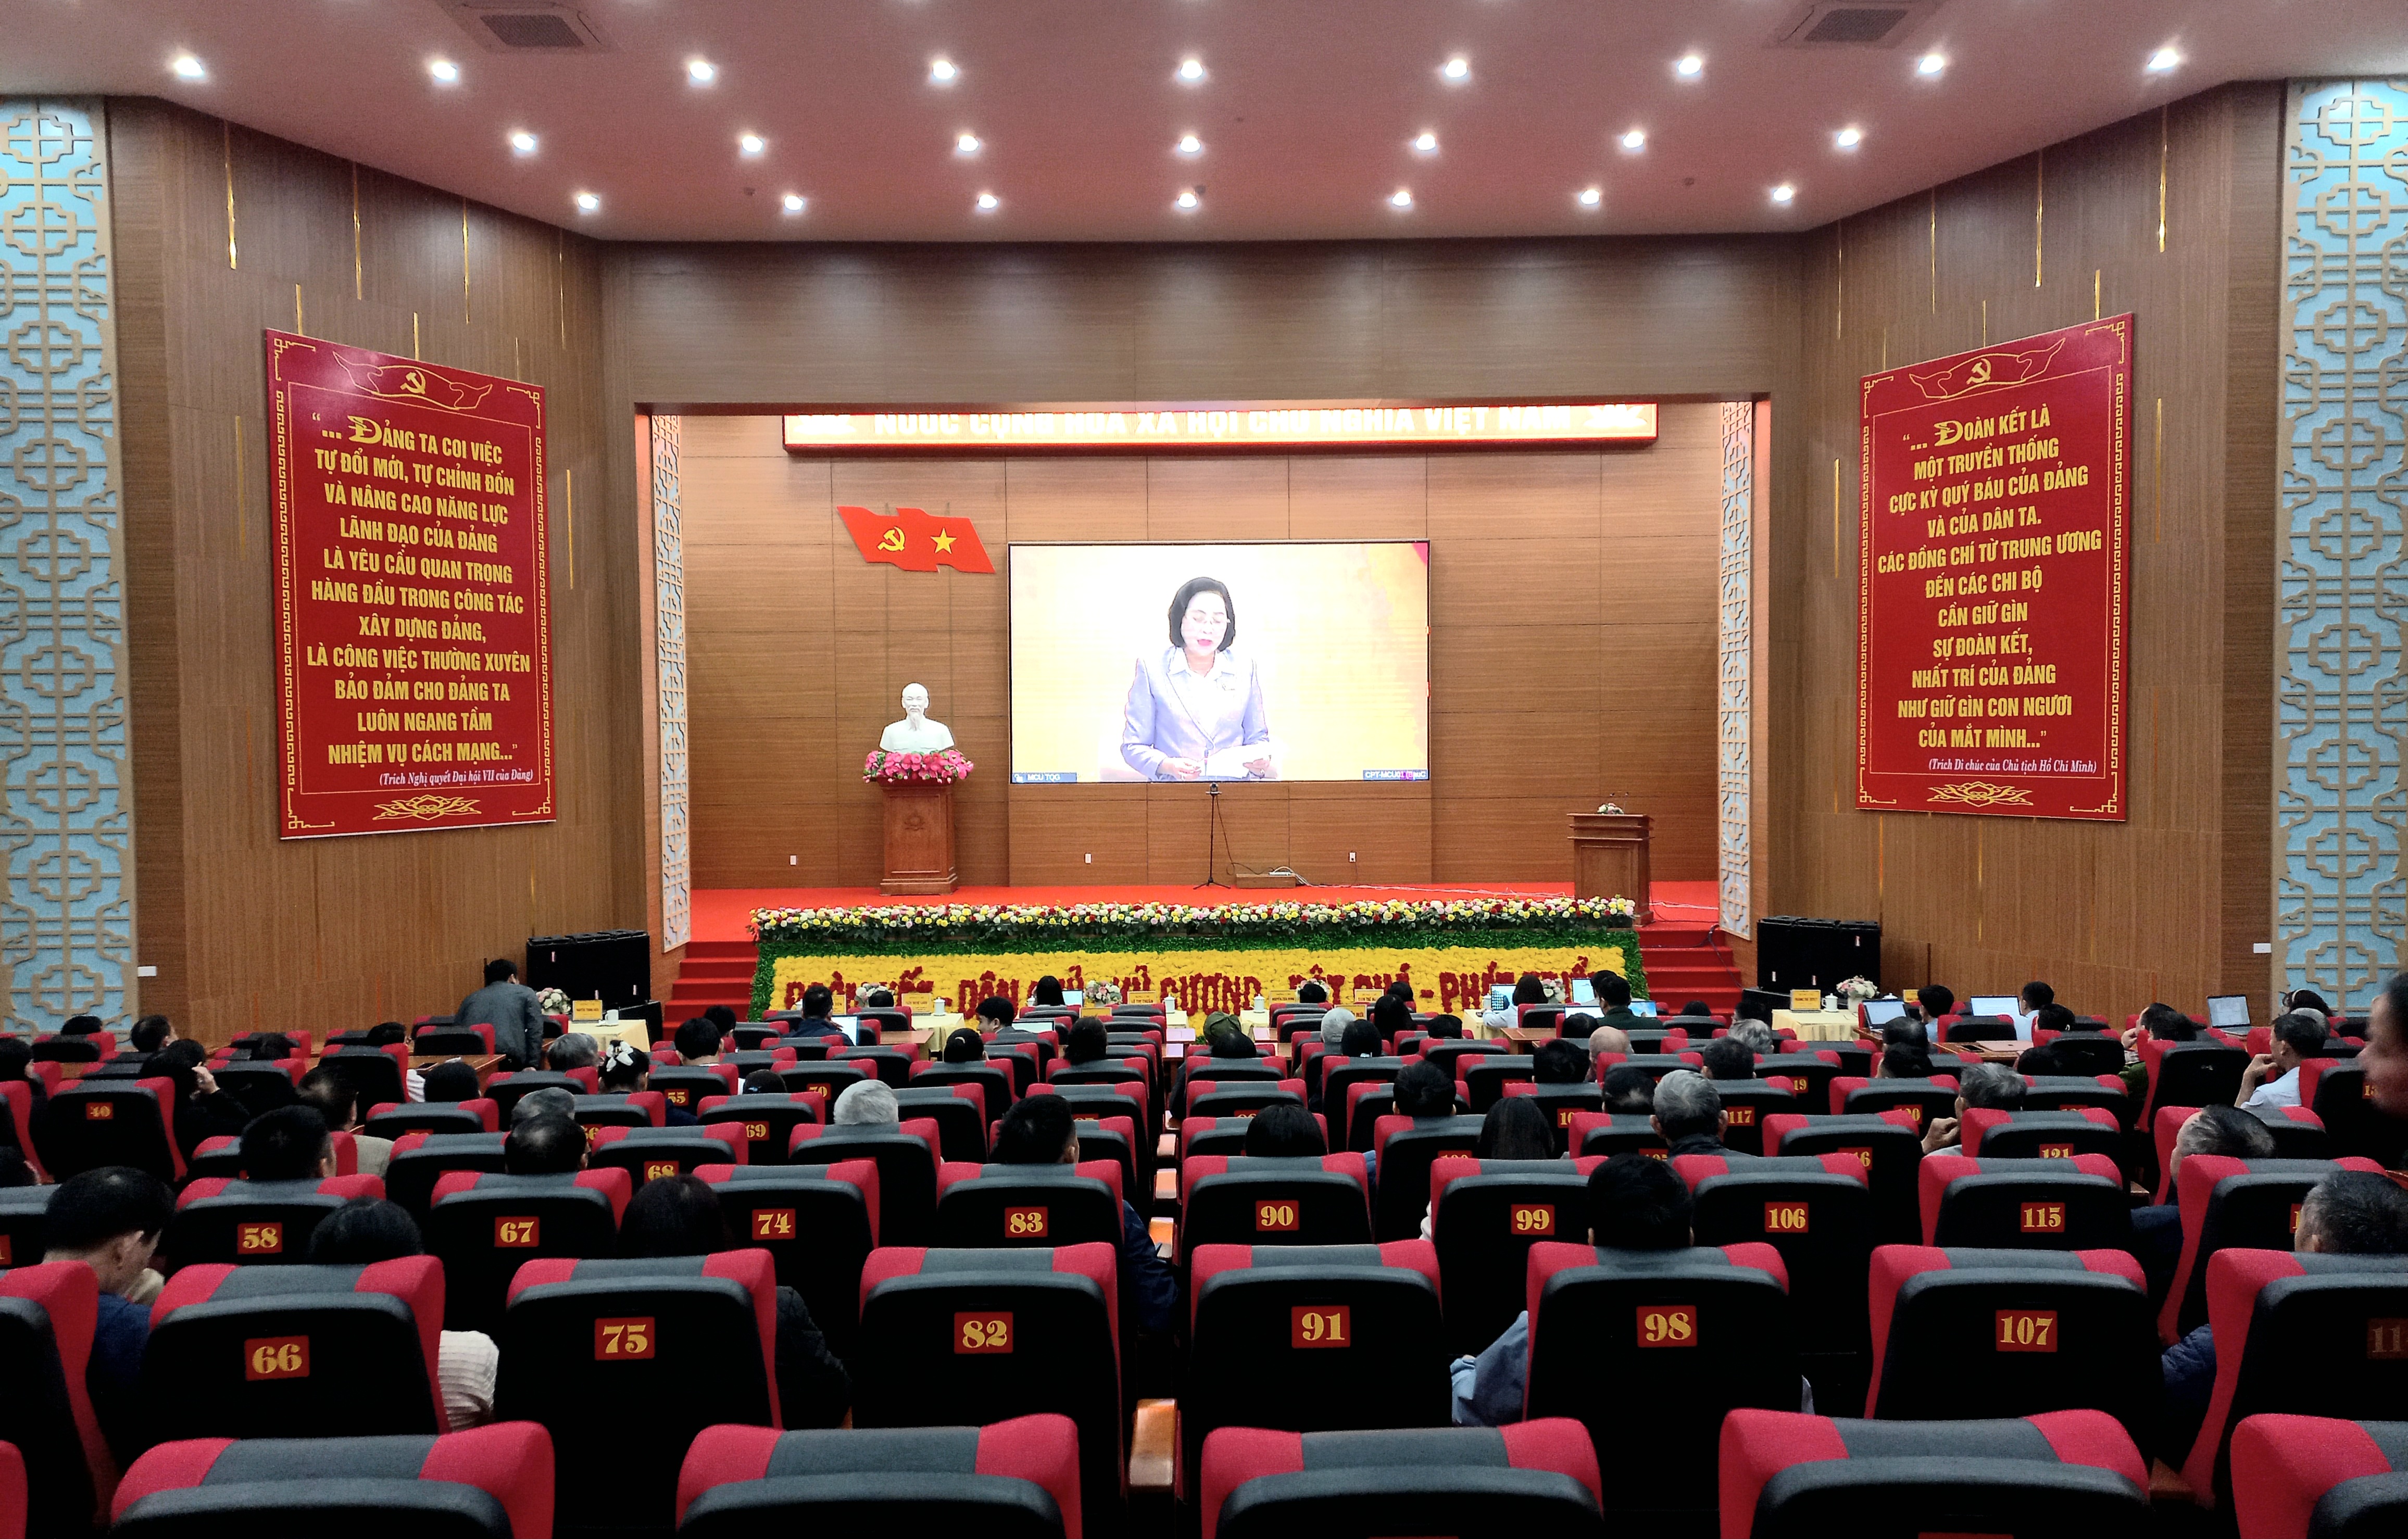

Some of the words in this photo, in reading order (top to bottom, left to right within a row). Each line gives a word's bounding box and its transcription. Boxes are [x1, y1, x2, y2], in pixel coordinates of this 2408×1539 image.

[1499, 406, 1570, 430] NAM
[1934, 416, 1995, 447] ĐOÀN
[1999, 406, 2027, 435] KẾT
[2031, 403, 2050, 429] LÀ
[347, 415, 415, 451] ĐẢNG
[419, 433, 438, 455] TA
[442, 437, 467, 459] COI
[470, 440, 503, 467] VIỆC
[314, 448, 338, 474] TỰ
[340, 447, 369, 475] ĐỔI
[373, 454, 409, 483] MỚI,
[412, 463, 434, 488] TỰ
[436, 463, 481, 491] CHỈNH
[485, 470, 515, 496] ĐỐN
[1914, 456, 1944, 482] MỘT
[1947, 445, 2003, 475] TRUYỀN
[2007, 434, 2059, 465] THỐNG
[1889, 491, 1916, 516] CỰC
[1920, 485, 1938, 509] KỲ
[1942, 480, 1970, 508] QUÝ
[1974, 476, 2004, 501] BÁU
[2008, 466, 2039, 496] CỦA
[2043, 461, 2088, 491] ĐẢNG
[324, 480, 347, 505] VÀ
[351, 484, 397, 511] NÂNG
[401, 493, 432, 515] CAO
[436, 495, 478, 521] NĂNG
[482, 503, 508, 527] LỰC
[340, 515, 383, 541] LÃNH
[387, 523, 419, 548] ĐẠO
[423, 520, 454, 549] CỦA
[457, 524, 497, 553] ĐẢNG
[1927, 514, 1946, 538] VÀ
[1949, 507, 1979, 535] CỦA
[1983, 507, 2014, 531] DÂN
[2018, 506, 2042, 526] TA.
[324, 546, 345, 570] LÀ
[349, 548, 380, 573] YÊU
[384, 549, 416, 575] CẦU
[420, 558, 462, 579] QUAN
[465, 562, 512, 586] TRỌNG
[1878, 550, 1905, 574] CÁC
[1908, 544, 1947, 570] ĐỒNG
[1950, 540, 1975, 565] CHÍ
[1978, 538, 1999, 563] TỪ
[2000, 536, 2052, 560] TRUNG
[2056, 529, 2102, 554] ƯƠNG
[311, 577, 358, 603] HÀNG
[362, 578, 395, 605] ĐẦU
[399, 587, 450, 609] TRONG
[454, 588, 494, 612] CÔNG
[497, 591, 523, 614] TÁC
[1925, 572, 1954, 599] ĐẾN
[1958, 571, 1987, 596] CÁC
[1991, 571, 2017, 592] CHI
[2021, 565, 2042, 592] BỘ
[1938, 601, 1968, 627] CẦN
[1972, 600, 1999, 625] GIỮ
[2001, 599, 2028, 623] GÌN
[359, 613, 391, 637] XÂY
[395, 617, 437, 642] DỰNG
[441, 614, 486, 644] ĐẢNG,
[307, 642, 329, 666] LÀ
[333, 643, 378, 668] CÔNG
[382, 646, 418, 673] VIỆC
[421, 647, 481, 671] THƯỜNG
[484, 650, 530, 673] XUYÊN
[1933, 636, 1954, 661] SỰ
[1955, 633, 1996, 657] ĐOÀN
[2000, 627, 2033, 655] KẾT,
[335, 672, 368, 700] BẢO
[372, 673, 409, 700] ĐẢM
[413, 681, 444, 700] CHO
[448, 674, 489, 701] ĐẢNG
[492, 683, 510, 701] TA
[1912, 663, 1949, 688] NHẤT
[1952, 664, 1975, 687] TRÍ
[1979, 659, 2009, 686] CỦA
[2013, 657, 2056, 685] ĐẢNG
[357, 708, 399, 731] LUÔN
[404, 712, 457, 731] NGANG
[460, 706, 493, 731] TẦM
[1898, 698, 1928, 718] NHƯ
[1930, 695, 1956, 717] GIỮ
[1958, 695, 1984, 717] GÌN
[1988, 697, 2019, 717] CON
[2023, 694, 2072, 716] NGƯƠI
[1918, 722, 1947, 748] CỦA
[1951, 723, 1983, 748] MẮT
[328, 740, 382, 768] NHIỆM
[386, 743, 407, 767] VỤ
[412, 739, 453, 762] CÁCH
[1929, 758, 1952, 770] (Trích
[1965, 759, 1984, 771] chúc
[1986, 758, 2000, 771] của
[2003, 759, 2018, 771] Chủ
[2021, 760, 2037, 775] tịch
[2039, 758, 2052, 772] Hồ
[2071, 760, 2097, 774] Minh)
[380, 773, 406, 786] (Trích
[408, 772, 427, 787] Nghị
[430, 770, 451, 786] quyết
[452, 771, 467, 786] Đại
[468, 771, 481, 785] hội
[483, 770, 495, 781] VII
[1794, 1079, 1807, 1091] 19
[746, 1124, 767, 1138] 69
[1729, 1110, 1752, 1124] 117
[758, 1213, 792, 1235] 74
[1010, 1212, 1043, 1233] 83
[1260, 1205, 1294, 1227] 90
[1516, 1209, 1550, 1230] 99
[1769, 1208, 1806, 1229] 106
[2024, 1207, 2061, 1228] 115
[243, 1227, 278, 1248] 58
[500, 1221, 534, 1243] 67
[603, 1324, 648, 1354] 75
[962, 1320, 1007, 1348] 82
[1301, 1313, 1345, 1341] 91
[1645, 1313, 1691, 1342] 98
[2000, 1316, 2053, 1345] 107
[2372, 1325, 2408, 1352] 11
[252, 1344, 302, 1373] 66
